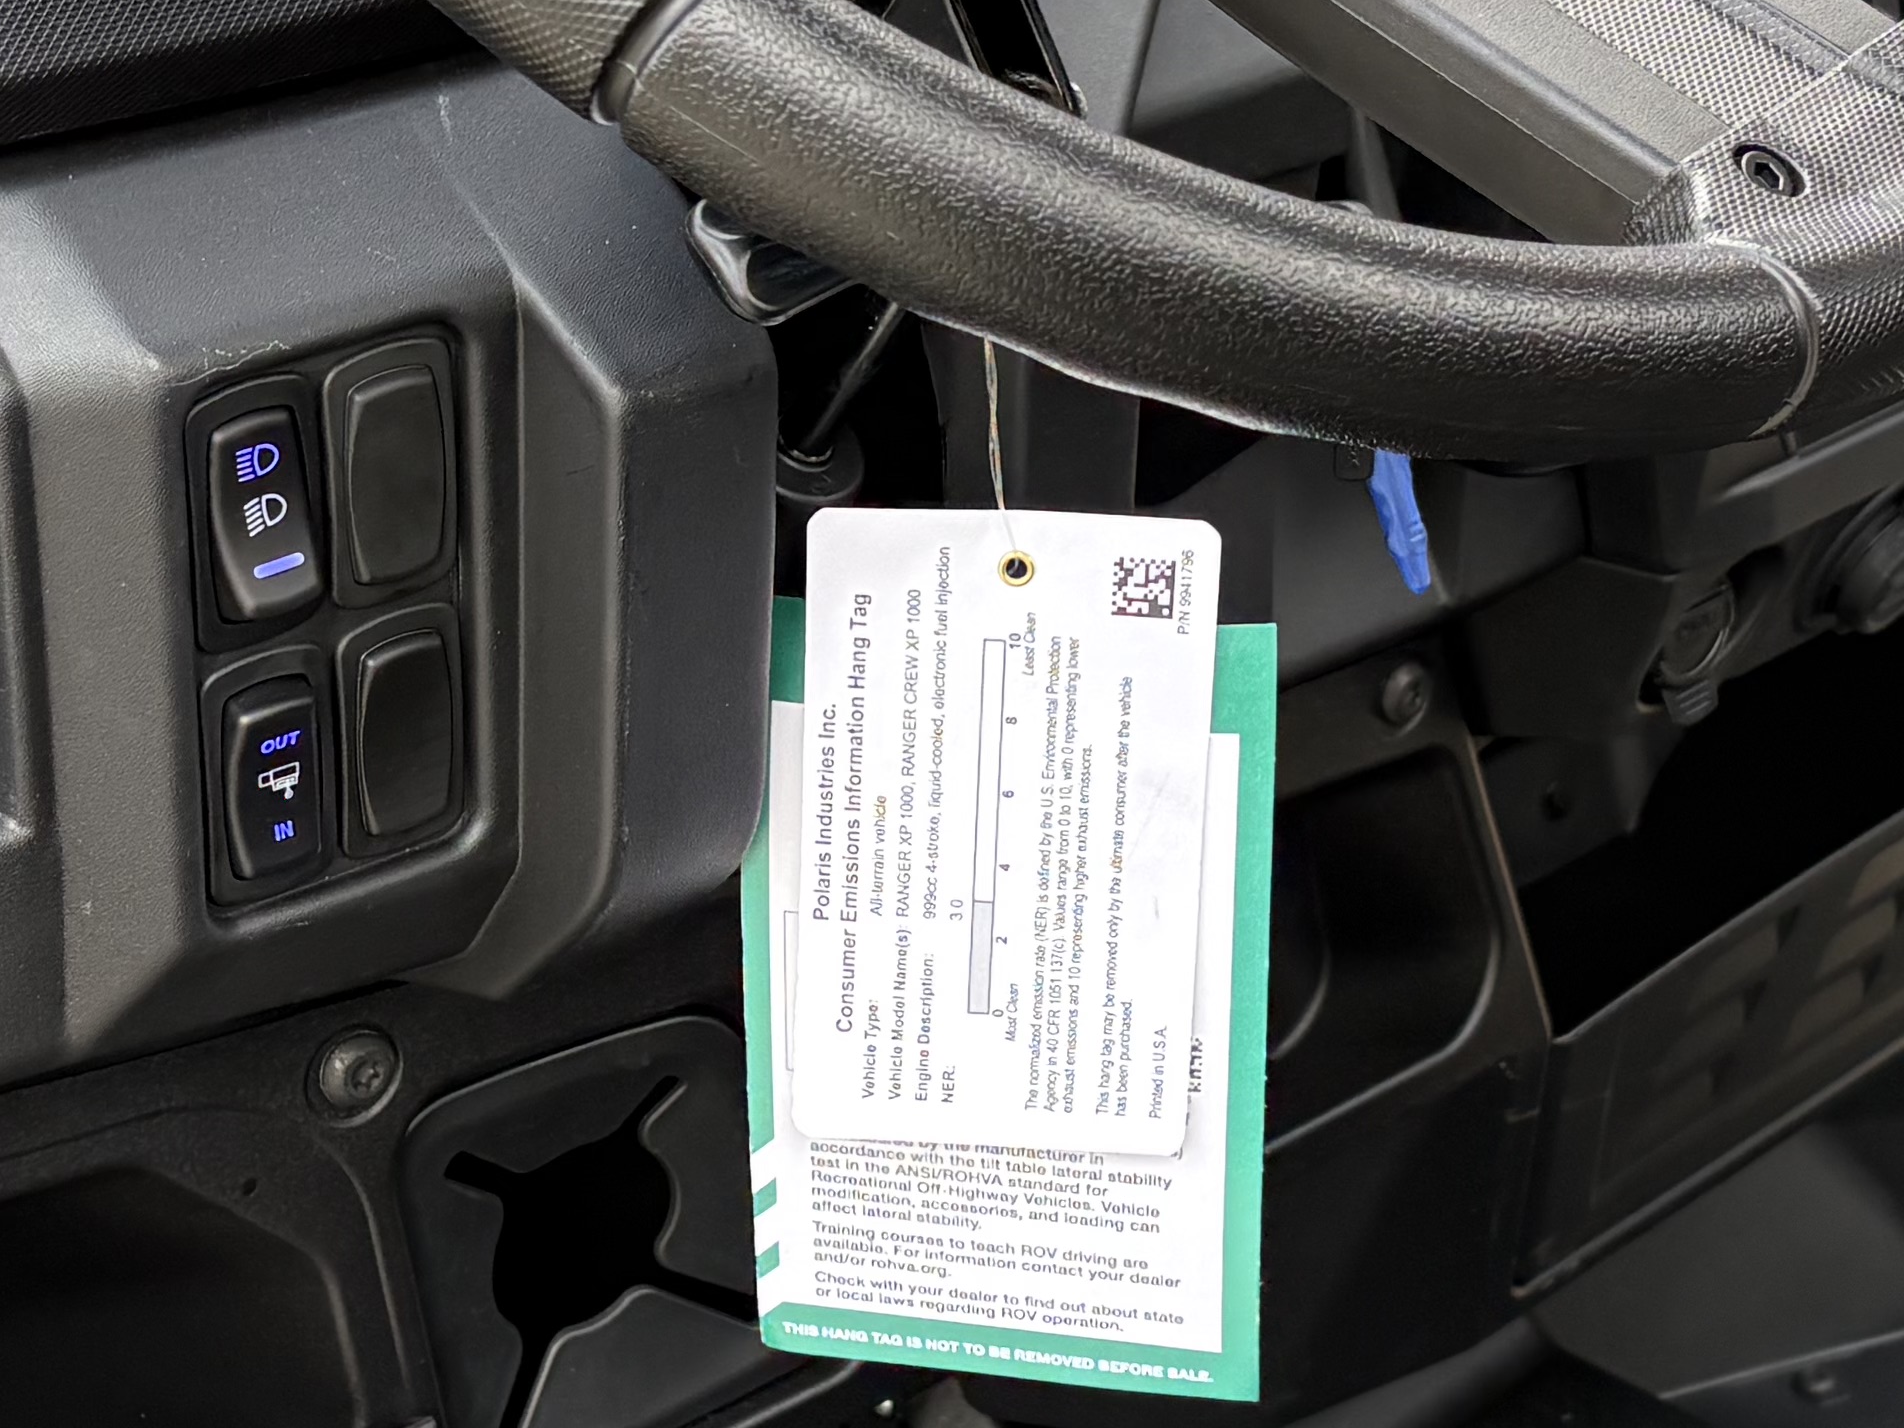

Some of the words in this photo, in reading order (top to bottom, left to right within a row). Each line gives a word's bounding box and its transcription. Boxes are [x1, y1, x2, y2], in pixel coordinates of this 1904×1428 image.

[934, 546, 953, 605] injection
[849, 594, 872, 630] Tag
[906, 589, 921, 623] 1000
[933, 610, 948, 636] fuel
[905, 629, 919, 651] XP
[1008, 633, 1021, 649] 10
[1023, 612, 1036, 644] Clean
[847, 637, 871, 689] Hang
[903, 655, 919, 705] CREW
[931, 640, 947, 710] electronic
[1021, 646, 1035, 676] Least
[260, 729, 301, 754] OUT
[818, 704, 836, 739] Inc.
[1005, 716, 1018, 725] 8
[844, 697, 865, 812] Information
[901, 709, 917, 777] RANGER
[814, 746, 835, 845] Industries
[899, 782, 916, 819] 1000,
[1002, 790, 1014, 799] 6
[273, 819, 295, 842] IN
[873, 795, 887, 844] vehicle
[898, 824, 912, 846] XP
[812, 852, 832, 921] Polaris
[840, 819, 860, 923] Emissions
[869, 849, 884, 917] All-terrain
[895, 851, 912, 918] RANGER
[998, 864, 1010, 872] 4
[922, 877, 938, 920] 999cc
[893, 924, 912, 991] Name(s):
[995, 936, 1008, 945] 2
[835, 928, 856, 1033] Consumer
[916, 954, 935, 1045] Description:
[1005, 983, 1019, 1013] Clean
[864, 999, 881, 1039] Type:
[891, 996, 905, 1041] Model
[991, 1009, 1004, 1018] 0
[1004, 1016, 1017, 1042] Most
[861, 1044, 877, 1099] Vehicle
[888, 1046, 903, 1100] Vehicle
[914, 1050, 932, 1101] Engine
[941, 1066, 955, 1103] NER:
[810, 1141, 905, 1161] accordance
[910, 1152, 944, 1164] with
[949, 1154, 975, 1168] the
[980, 1158, 1000, 1170] tilt
[1005, 1160, 1046, 1175] table
[1052, 1165, 1102, 1181] lateral
[1107, 1171, 1172, 1191] stability
[810, 1155, 840, 1169] test
[845, 1158, 859, 1171] in
[864, 1161, 890, 1175] the
[1008, 1177, 1080, 1194] standard
[1086, 1183, 1108, 1197] for
[811, 1169, 911, 1192] Recreational
[917, 1181, 1018, 1205] Off-Highway
[1101, 1200, 1160, 1218] Vehicle
[812, 1200, 857, 1216] affect
[862, 1204, 911, 1221] lateral
[1028, 1211, 1059, 1223] and
[1064, 1212, 1124, 1233] loading
[1130, 1222, 1160, 1233] can
[812, 1220, 875, 1243] Training
[880, 1231, 944, 1247] courses
[949, 1238, 965, 1250] to
[970, 1240, 1015, 1255] teach
[1021, 1244, 1057, 1259] ROV
[1062, 1250, 1117, 1269] driving
[1123, 1259, 1148, 1270] are
[814, 1252, 865, 1266] and/or
[893, 1245, 920, 1258] For
[925, 1248, 1016, 1270] information
[1021, 1262, 1083, 1277] contact
[1088, 1269, 1124, 1281] your
[1129, 1272, 1181, 1288] dealer
[814, 1270, 865, 1288] Check
[869, 1280, 903, 1292] with
[908, 1284, 943, 1296] your
[948, 1288, 998, 1303] dealer
[1003, 1294, 1019, 1305] to
[1024, 1295, 1055, 1309] find
[1059, 1302, 1086, 1313] out
[1091, 1304, 1138, 1319] about
[1144, 1311, 1184, 1325] state
[815, 1287, 831, 1297] or
[836, 1287, 873, 1302] local
[879, 1292, 914, 1307] laws
[920, 1300, 995, 1319] regarding
[1001, 1307, 1036, 1321] ROV
[782, 1321, 820, 1337] THIS
[821, 1326, 869, 1343] HANG
[871, 1331, 903, 1347] TAG
[906, 1336, 923, 1349] IS
[925, 1338, 960, 1353] NOT
[962, 1342, 986, 1357] TO
[988, 1345, 1011, 1360] BE
[1013, 1348, 1095, 1370] REMOVED
[1097, 1359, 1164, 1378] BEFORE
[1167, 1367, 1214, 1383] SALE.
